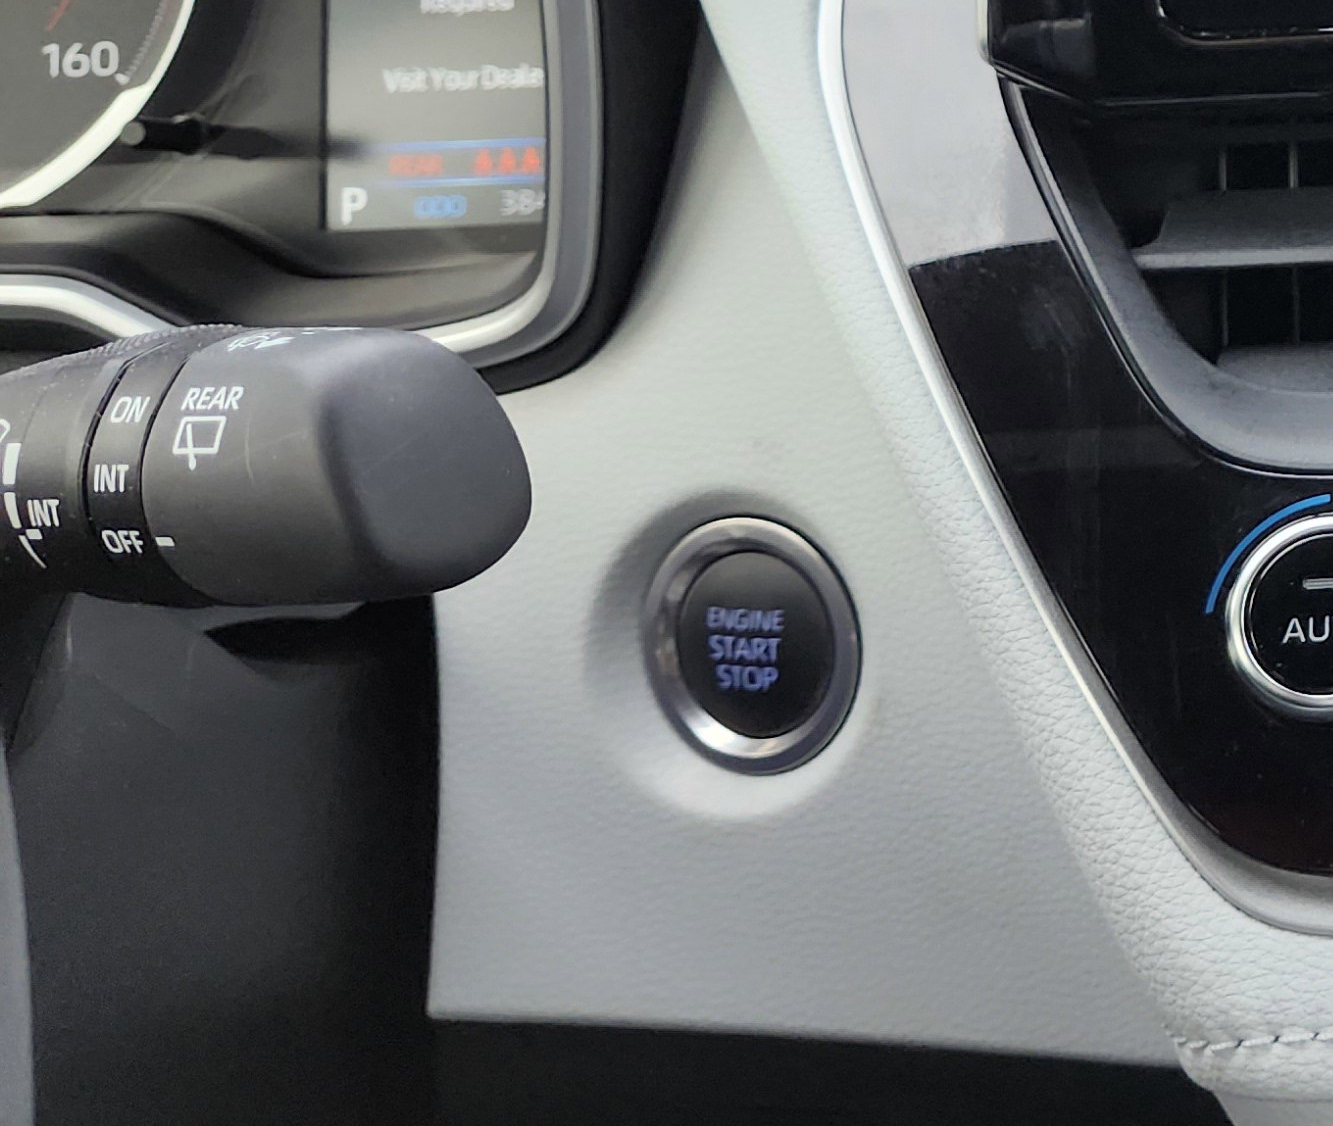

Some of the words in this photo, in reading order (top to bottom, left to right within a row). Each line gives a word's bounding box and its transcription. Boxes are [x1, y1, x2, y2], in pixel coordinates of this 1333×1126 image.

[41, 40, 120, 78] 160
[382, 66, 428, 94] Visit
[428, 66, 478, 92] Your
[340, 187, 368, 226] P
[110, 396, 150, 423] ON
[181, 386, 244, 410] REAR
[93, 464, 129, 493] INT
[27, 499, 60, 527] INT
[101, 529, 144, 554] OFF
[706, 606, 784, 632] ENGINE
[709, 634, 782, 662] START
[715, 663, 779, 692] STOP
